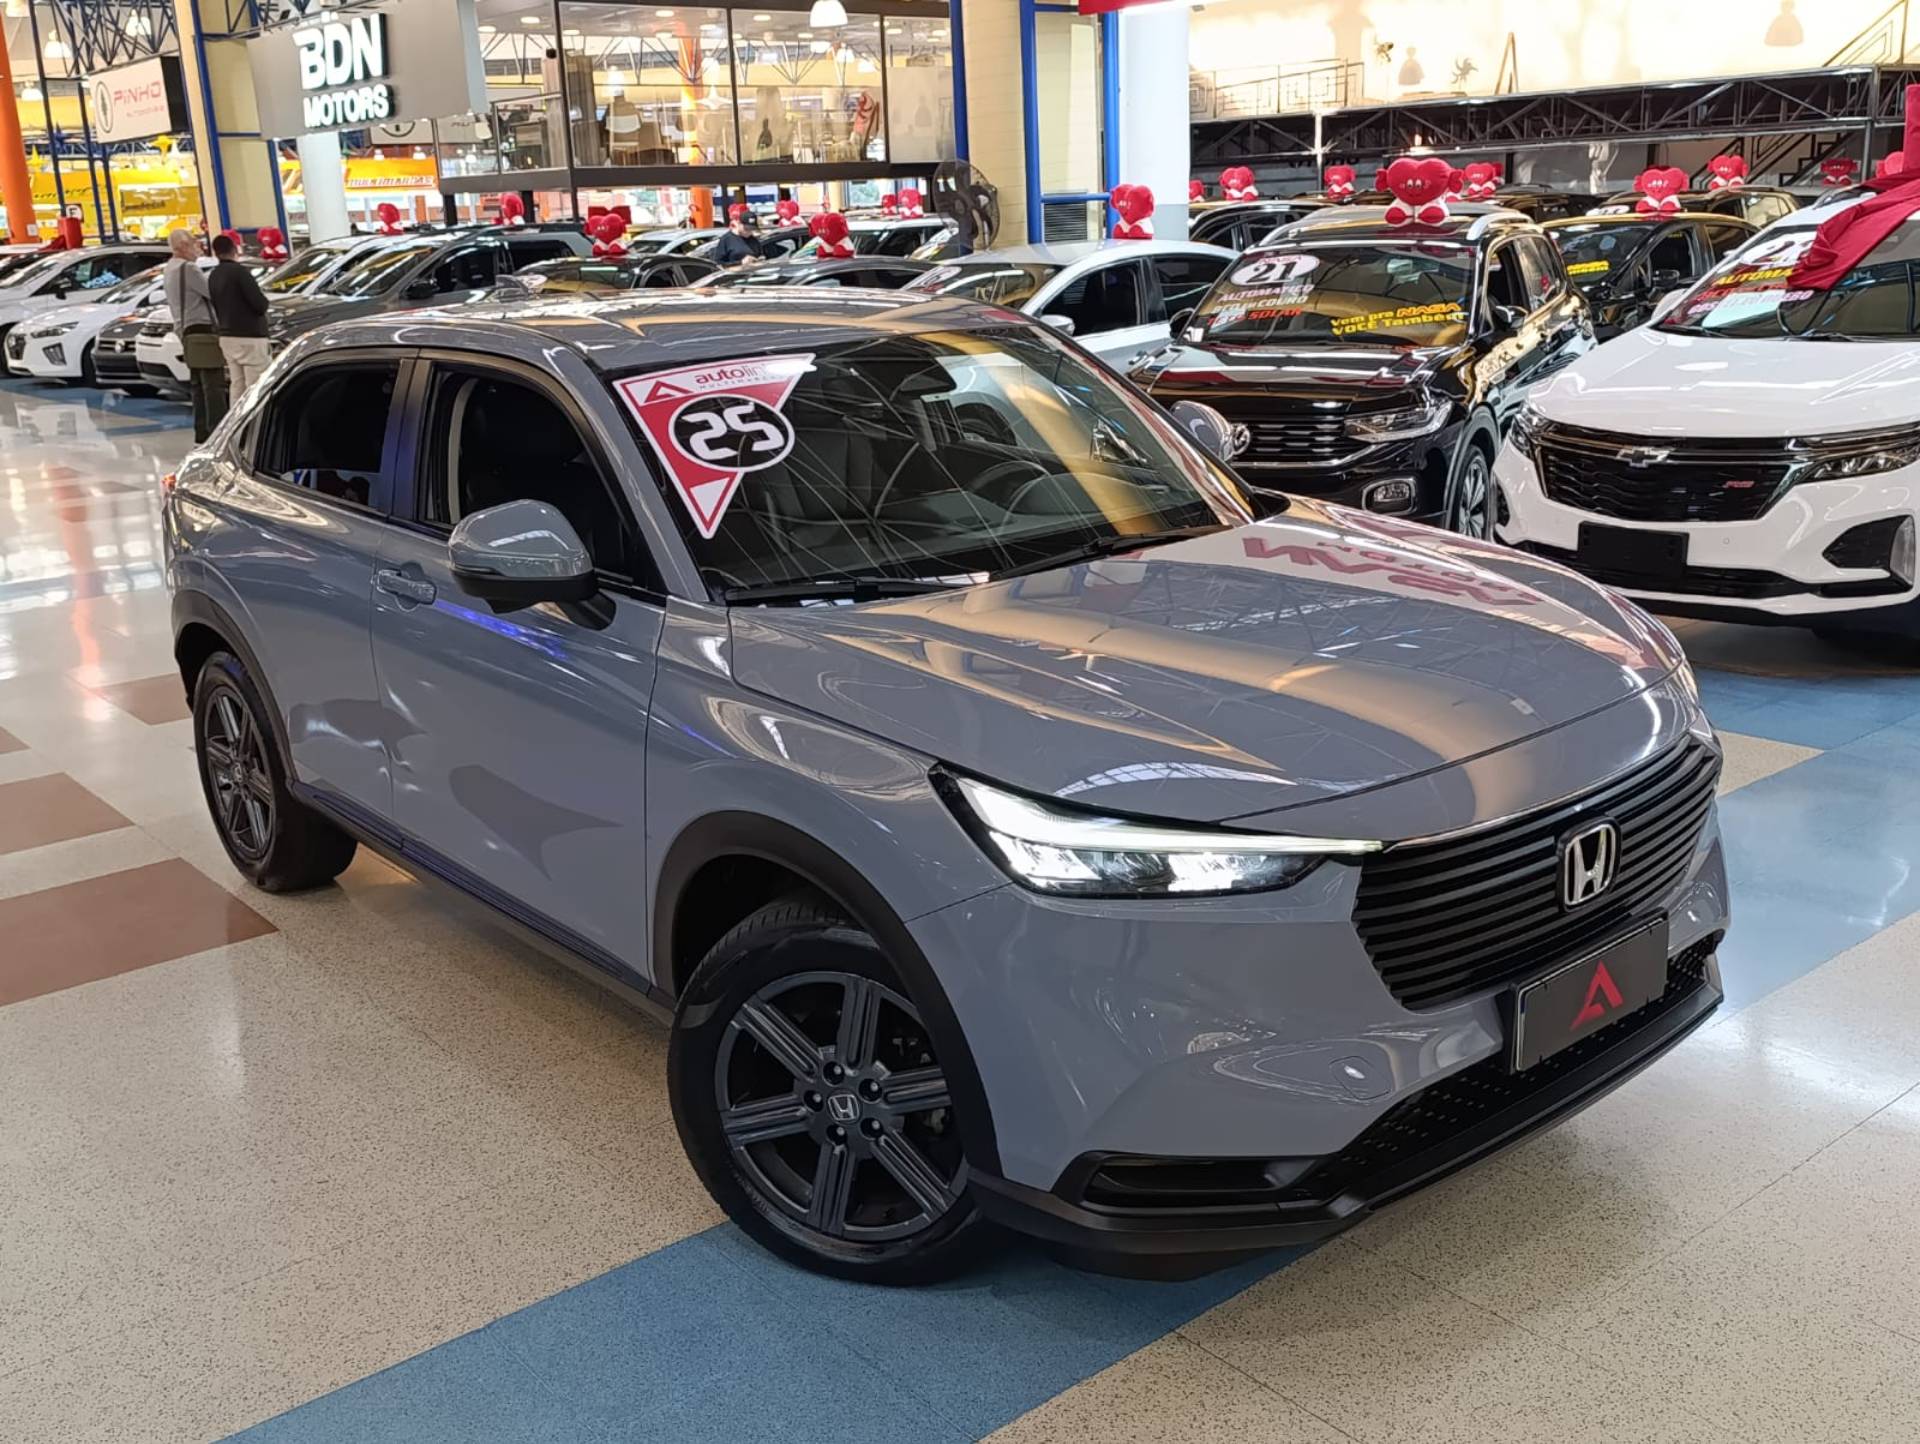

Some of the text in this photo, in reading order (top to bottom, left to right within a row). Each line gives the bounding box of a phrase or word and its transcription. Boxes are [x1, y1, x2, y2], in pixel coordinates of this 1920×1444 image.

[292, 13, 385, 90] BDN
[303, 83, 390, 128] MOTORS
[1245, 261, 1299, 283] 21
[1258, 296, 1308, 308] COURO
[1396, 303, 1461, 317] NASA
[681, 402, 785, 460] 25
